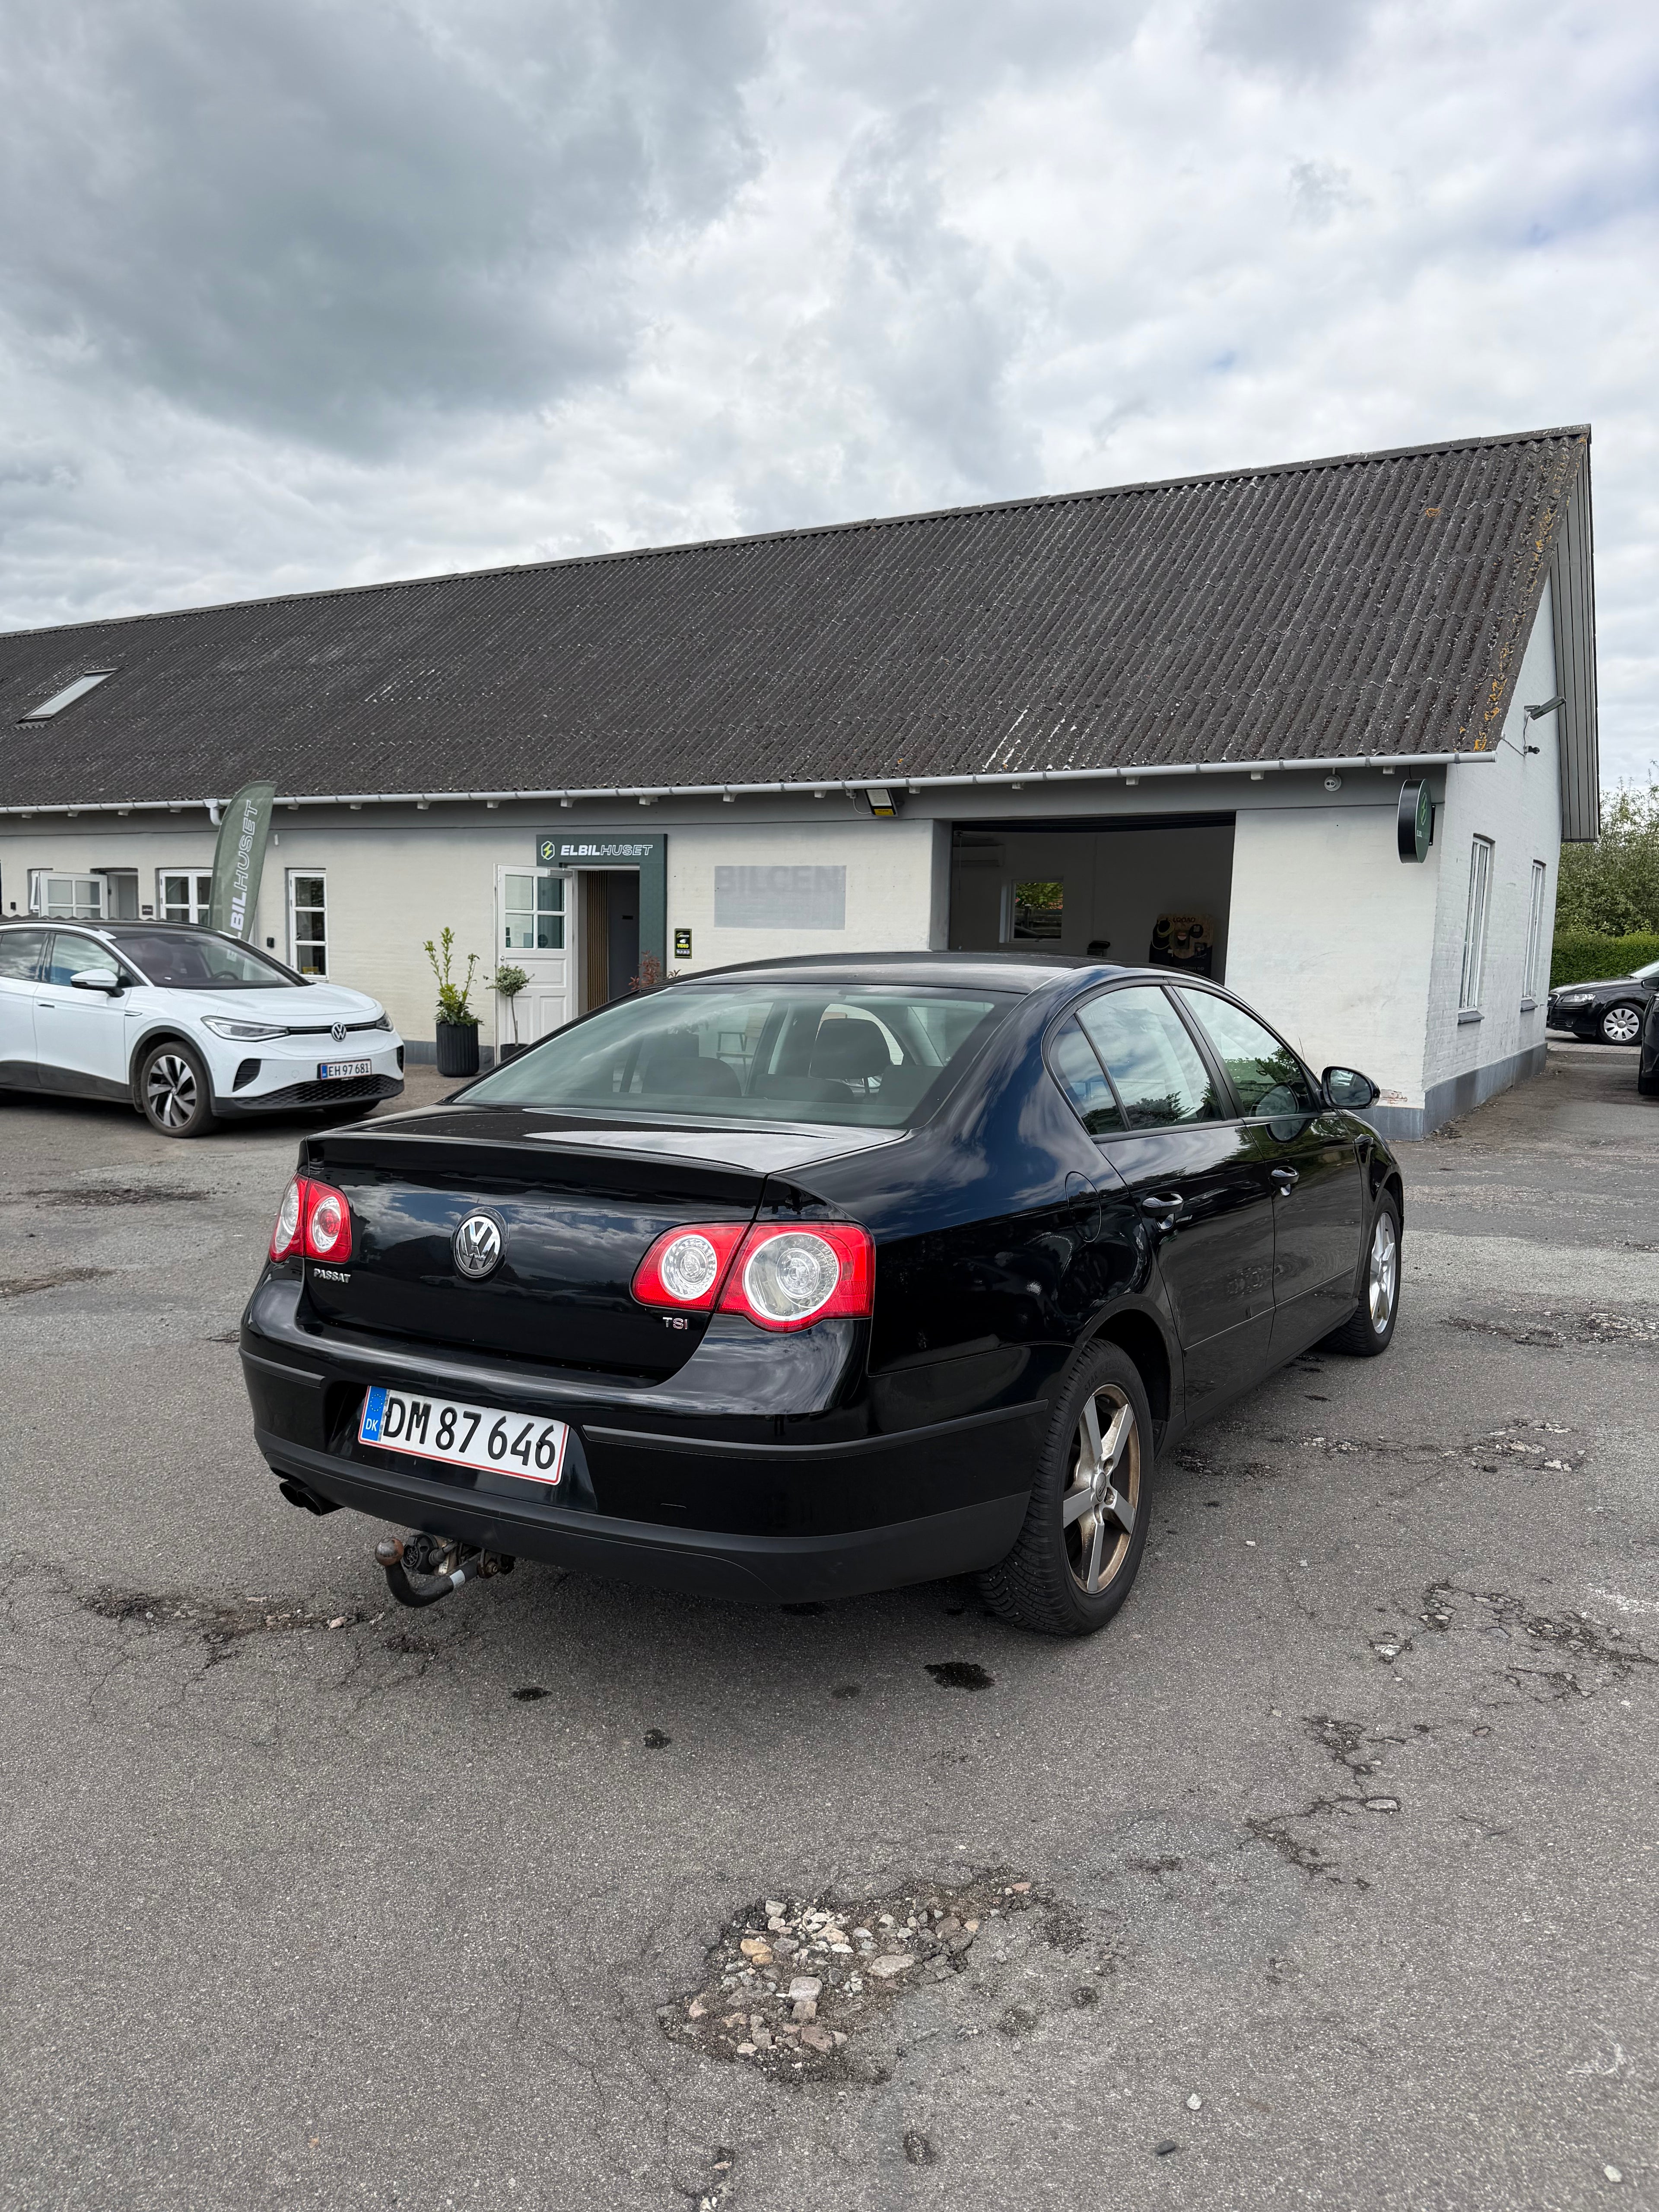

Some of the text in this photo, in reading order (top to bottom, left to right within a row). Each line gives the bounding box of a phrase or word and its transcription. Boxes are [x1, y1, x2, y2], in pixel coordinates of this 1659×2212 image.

[560, 844, 654, 856] ELBILHUSET
[329, 1065, 340, 1076] EH
[343, 1065, 353, 1075] 97
[355, 1063, 369, 1074] 681
[313, 1268, 351, 1283] PASSAT
[662, 1316, 688, 1330] TSI
[365, 1396, 556, 1470] DK DM 87 646
